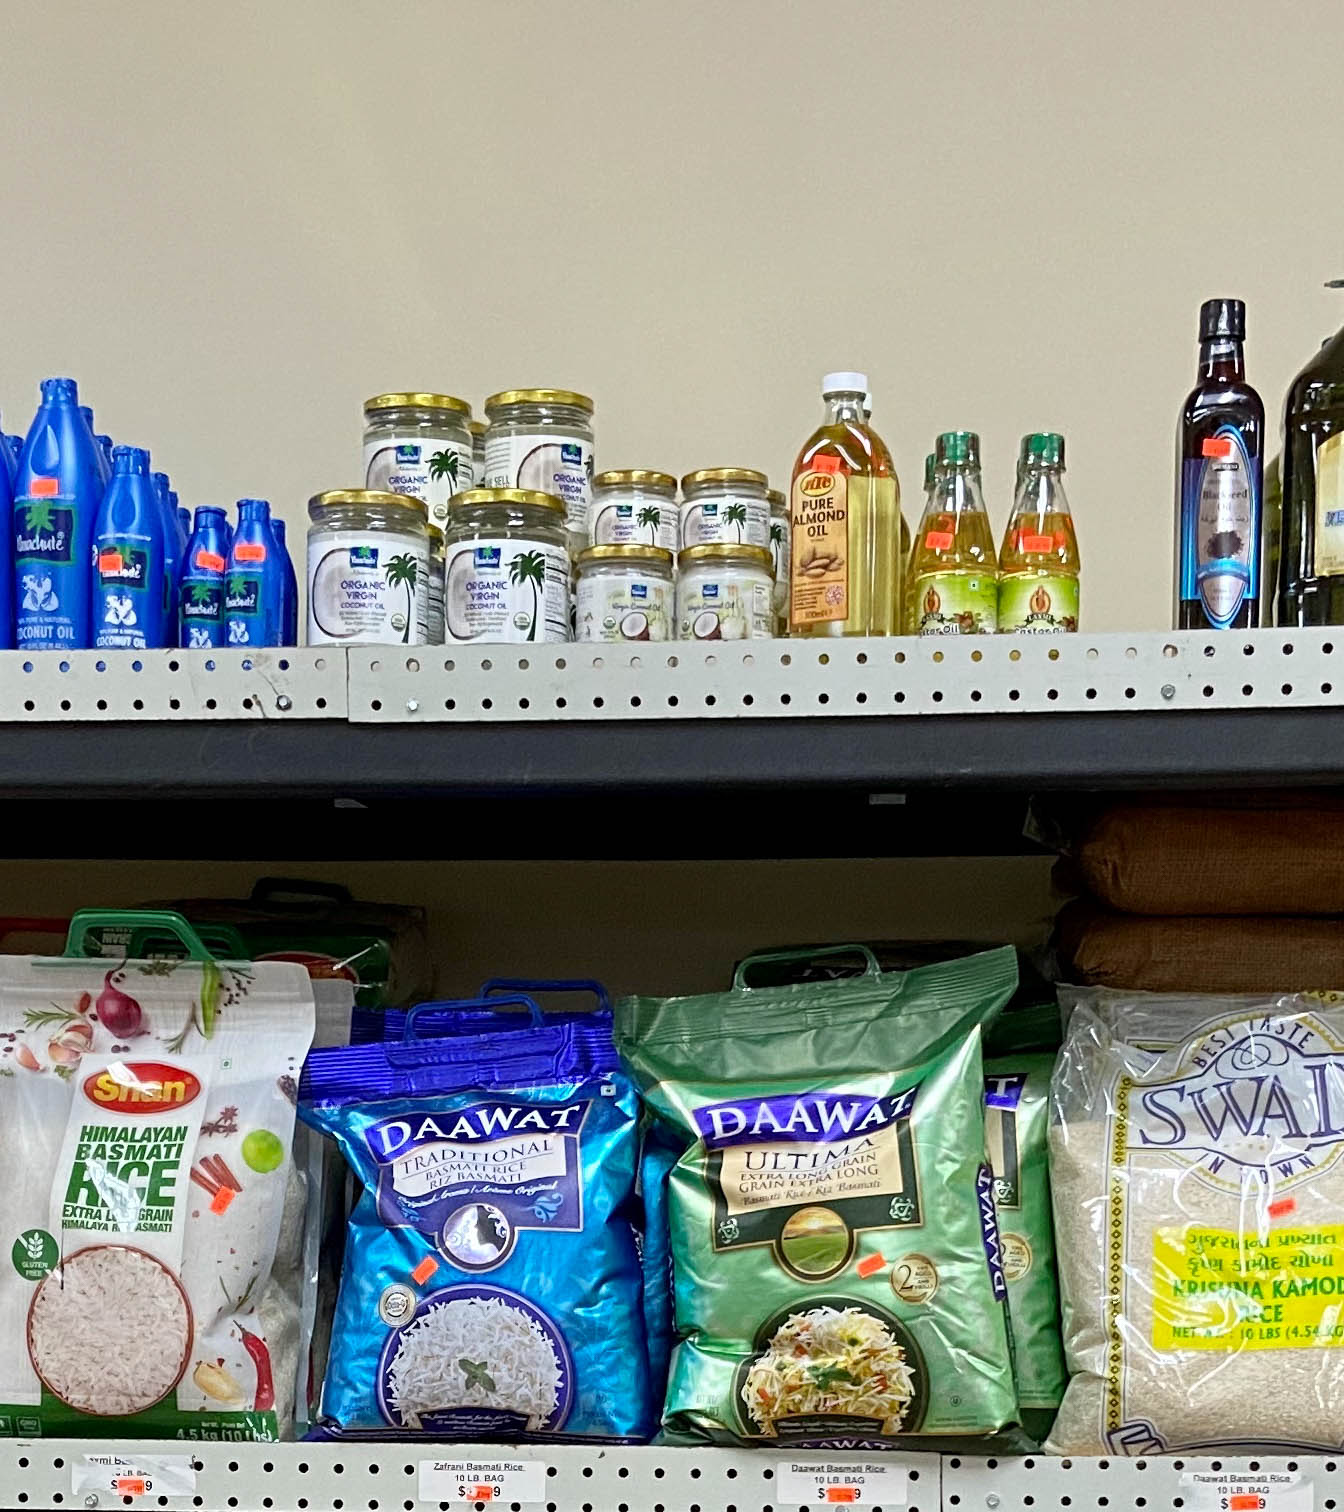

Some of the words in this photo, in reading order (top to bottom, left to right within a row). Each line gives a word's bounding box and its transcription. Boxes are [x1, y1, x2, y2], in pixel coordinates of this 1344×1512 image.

[801, 498, 834, 511] PURE
[793, 509, 845, 528] ALMOND
[807, 524, 828, 537] OIL
[340, 580, 386, 592] ORGANIC
[347, 591, 377, 600] VIRGIN
[709, 1084, 917, 1141] DAAWAT
[80, 1125, 188, 1143] HIMALAYAN
[379, 1104, 580, 1155] DAAWAT
[76, 1143, 182, 1160] BASMATI
[401, 1140, 553, 1175] TRADITIONAL
[744, 1136, 875, 1172] ULTIMA
[65, 1161, 180, 1207] RICE
[467, 1462, 501, 1471] Basmati
[455, 1474, 464, 1482] 10
[485, 1474, 505, 1482] BAG
